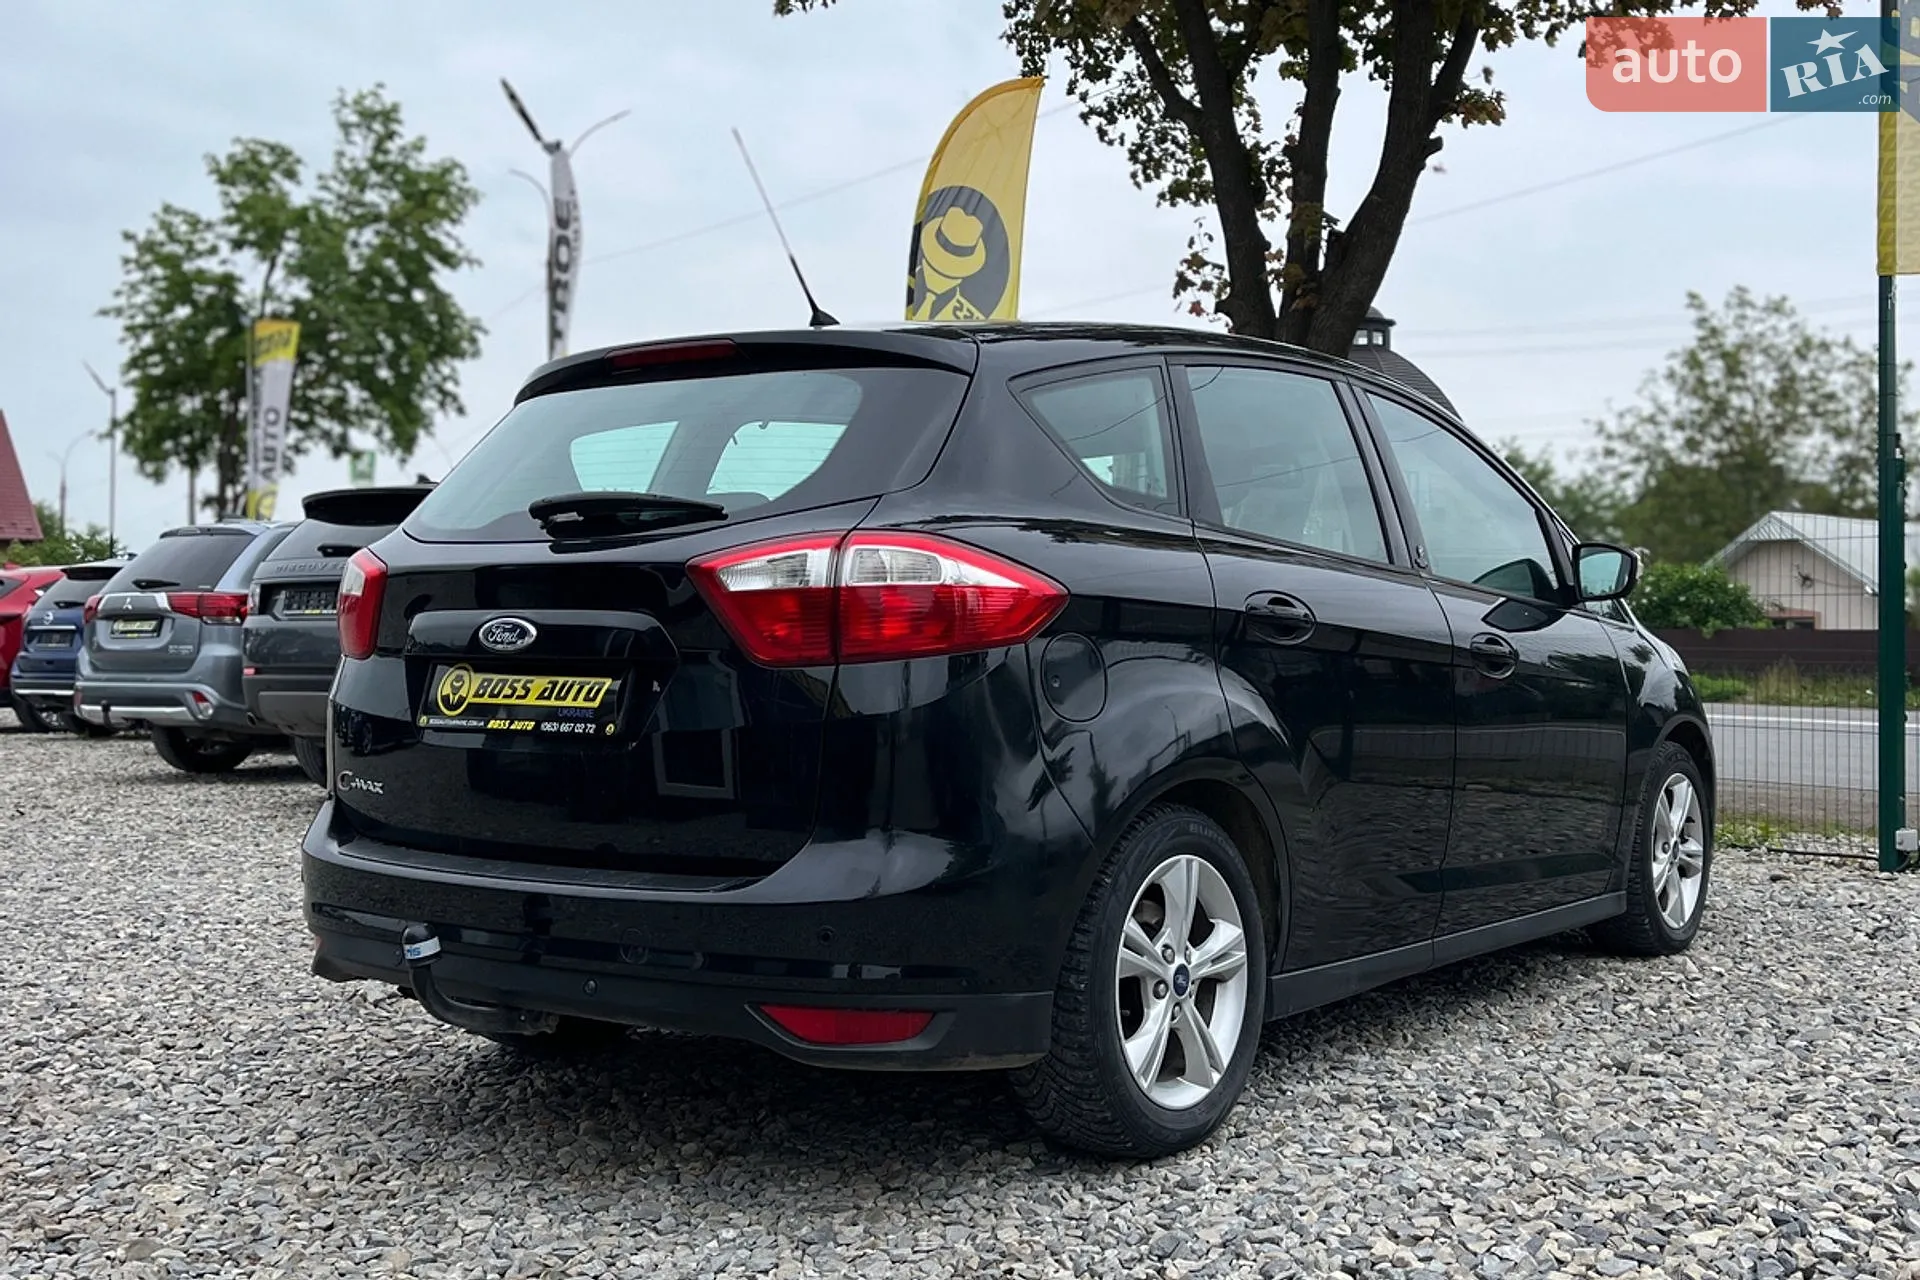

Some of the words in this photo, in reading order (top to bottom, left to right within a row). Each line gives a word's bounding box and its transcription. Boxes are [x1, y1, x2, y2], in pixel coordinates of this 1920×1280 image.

[488, 623, 521, 643] Ford
[472, 678, 535, 700] BOSS
[535, 679, 606, 702] AUTO
[557, 706, 595, 719] UKRAINE
[486, 719, 510, 730] BOSS
[509, 720, 536, 731] AUTO
[585, 723, 596, 734] 72
